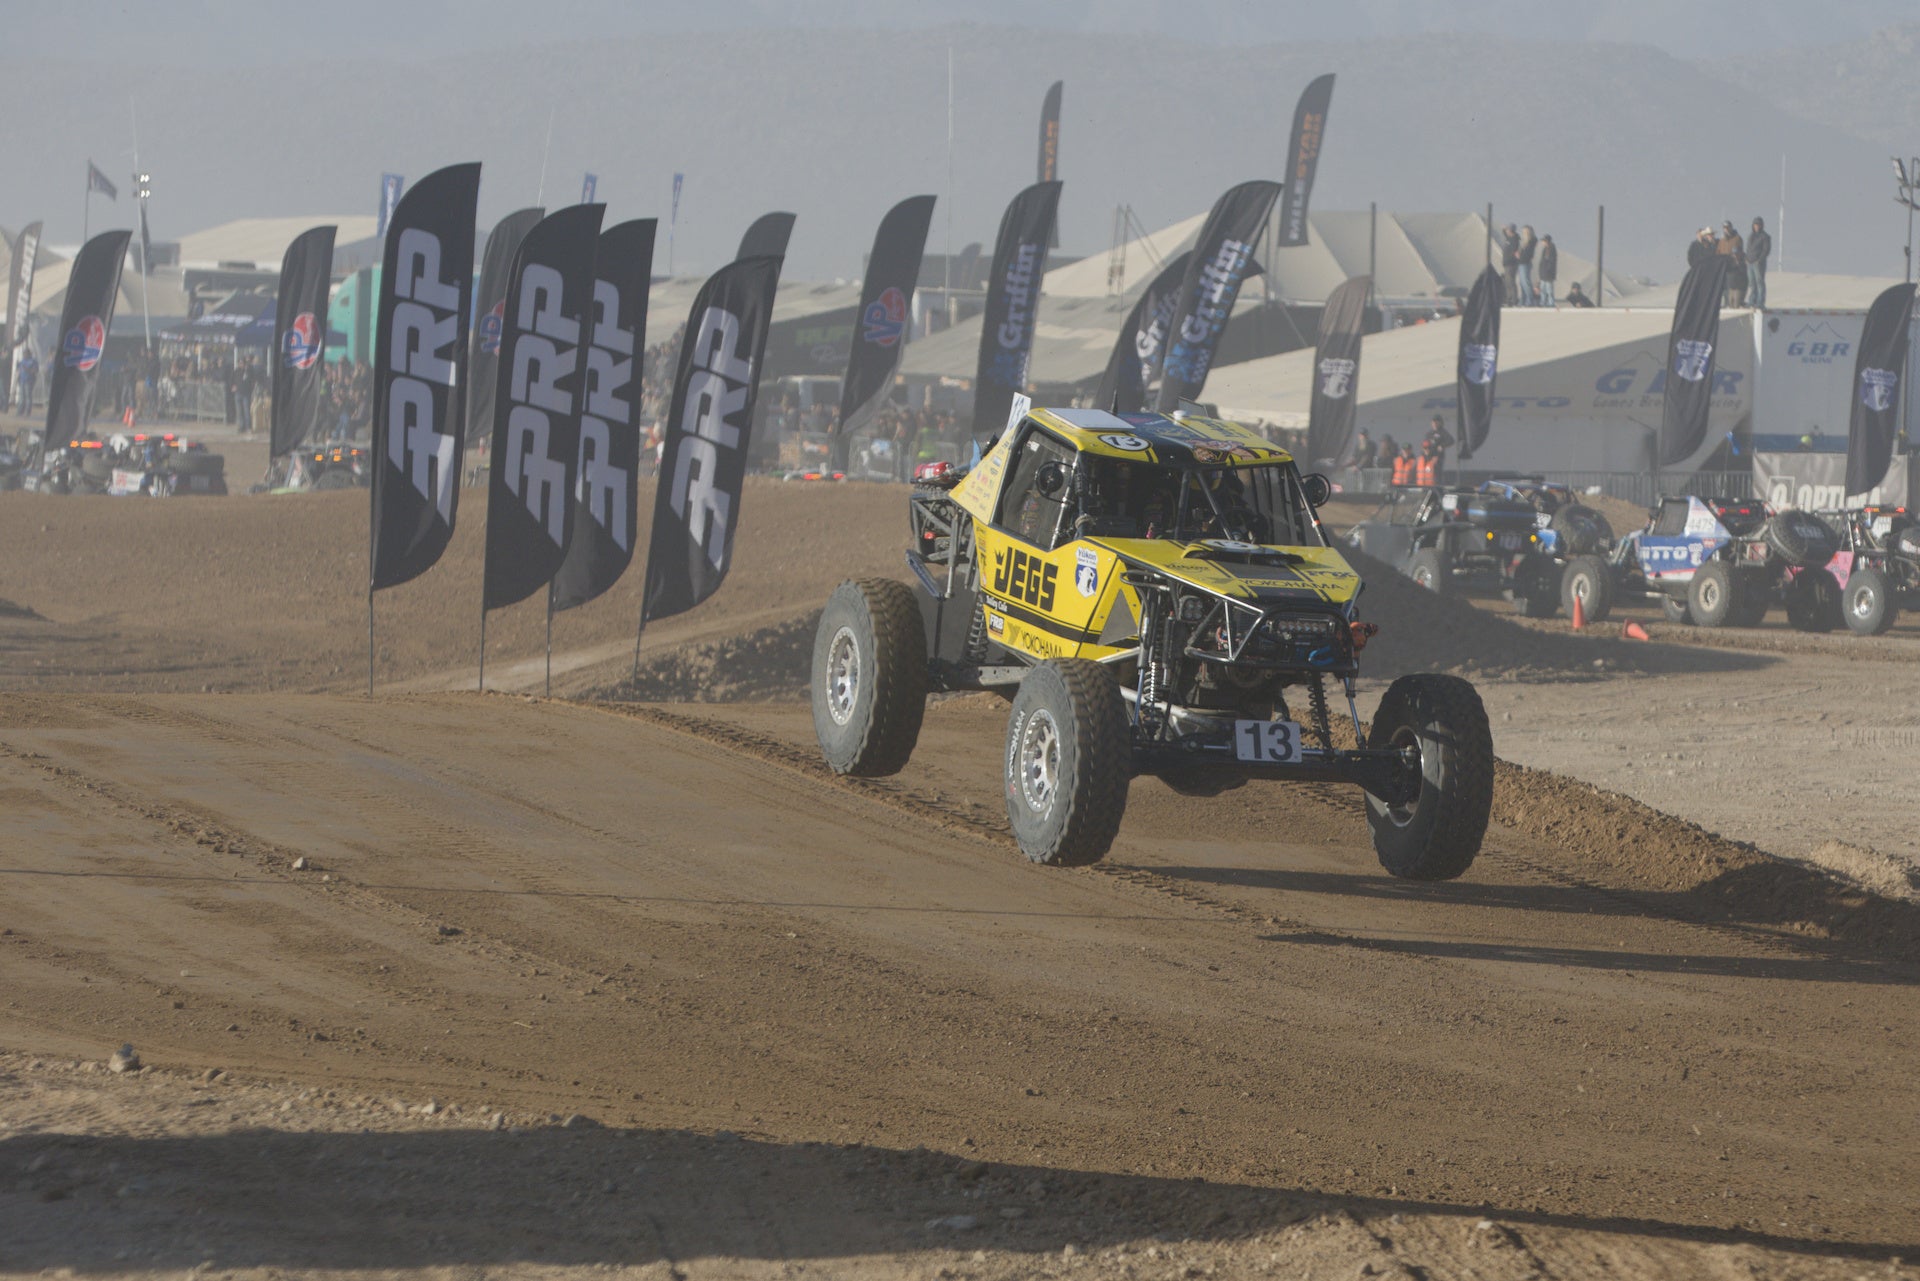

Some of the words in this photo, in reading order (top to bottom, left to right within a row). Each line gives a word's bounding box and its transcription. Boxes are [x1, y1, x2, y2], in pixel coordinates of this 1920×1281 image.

[998, 243, 1037, 349] Griffin
[1180, 239, 1243, 343] Griffin
[388, 227, 461, 527] PRP
[1788, 342, 1850, 356] GBR
[505, 263, 581, 549] PRP
[669, 306, 752, 571] PRP
[1106, 435, 1143, 447] 13
[994, 546, 1058, 612] JEGS
[1241, 579, 1345, 591] YOKOHAMA
[1021, 630, 1062, 658] YOKOHAMA
[1244, 722, 1293, 760] 13
